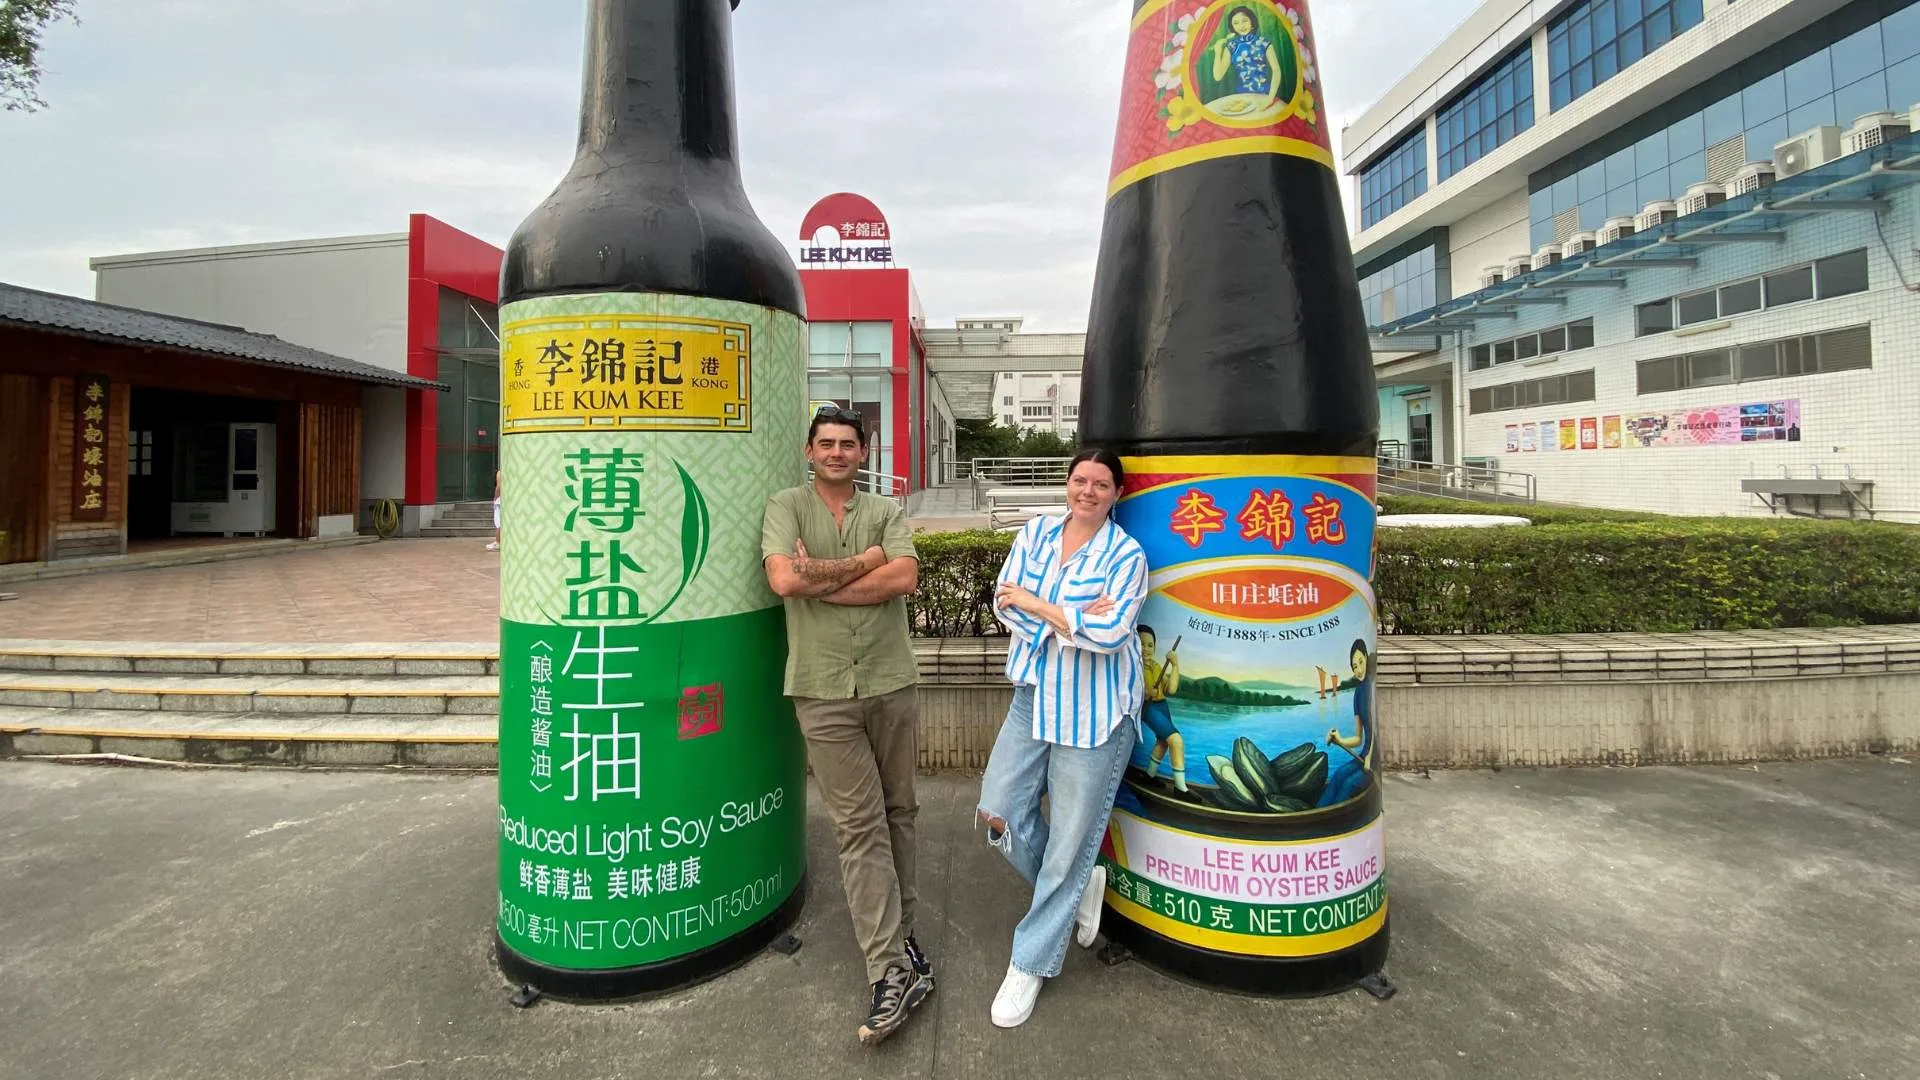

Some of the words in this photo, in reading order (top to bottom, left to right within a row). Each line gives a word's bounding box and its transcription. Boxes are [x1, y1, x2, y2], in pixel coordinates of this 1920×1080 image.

[800, 248, 826, 262] LEE
[829, 247, 862, 262] KUM
[865, 247, 891, 262] KEE
[535, 338, 684, 386] 李錦記
[701, 357, 720, 376] 港
[691, 376, 728, 390] KONG
[533, 391, 564, 411] LEE
[572, 390, 629, 411] KUM
[639, 390, 684, 411] KEE
[1170, 488, 1349, 550] 李錦記
[1211, 582, 1320, 606] 旧庄蚝油
[1278, 626, 1316, 641] SINCE
[1317, 615, 1341, 634] 1888
[499, 804, 578, 856] Reduced
[585, 822, 653, 863] Light
[660, 815, 714, 849] Soy
[720, 787, 784, 833] Sauce
[1203, 847, 1245, 872] LEE
[1251, 853, 1298, 873] KUM
[1304, 848, 1341, 871] KEE
[519, 857, 593, 901] 鲜香薄盐
[607, 855, 702, 900] 美味健康
[1145, 854, 1240, 896] PREMIUM
[1246, 872, 1329, 898] OYSTER
[1334, 855, 1377, 891] SAUCE
[1209, 904, 1234, 930] 克
[1250, 909, 1297, 934] NET
[563, 920, 608, 950] NET
